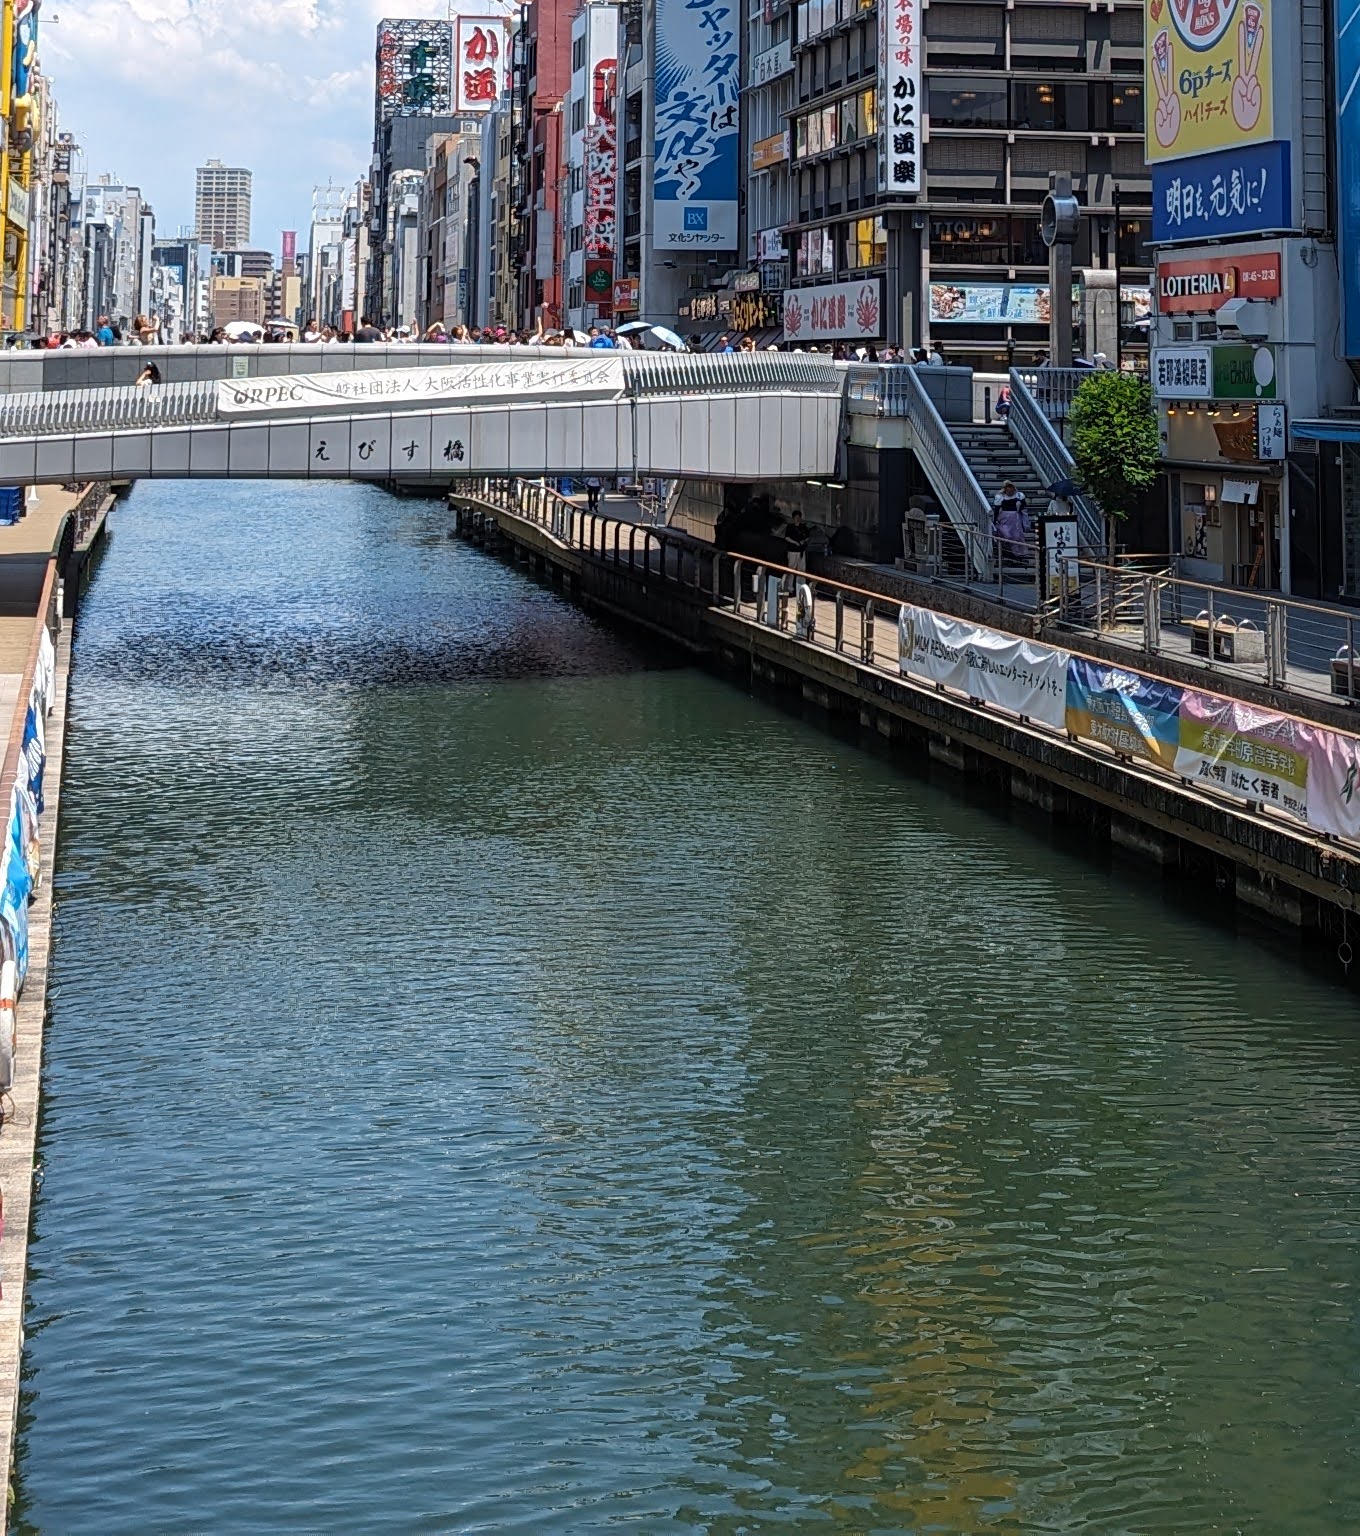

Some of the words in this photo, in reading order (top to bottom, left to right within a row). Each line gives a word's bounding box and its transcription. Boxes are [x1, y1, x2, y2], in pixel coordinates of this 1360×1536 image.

[1193, 12, 1215, 30] SNOW
[892, 74, 916, 184] かに道楽
[686, 212, 706, 226] BX
[1160, 272, 1221, 297] LOTTERIA
[333, 377, 419, 397] 般社団法人
[314, 438, 466, 463] えびす橋
[1261, 426, 1272, 458] つけ麺
